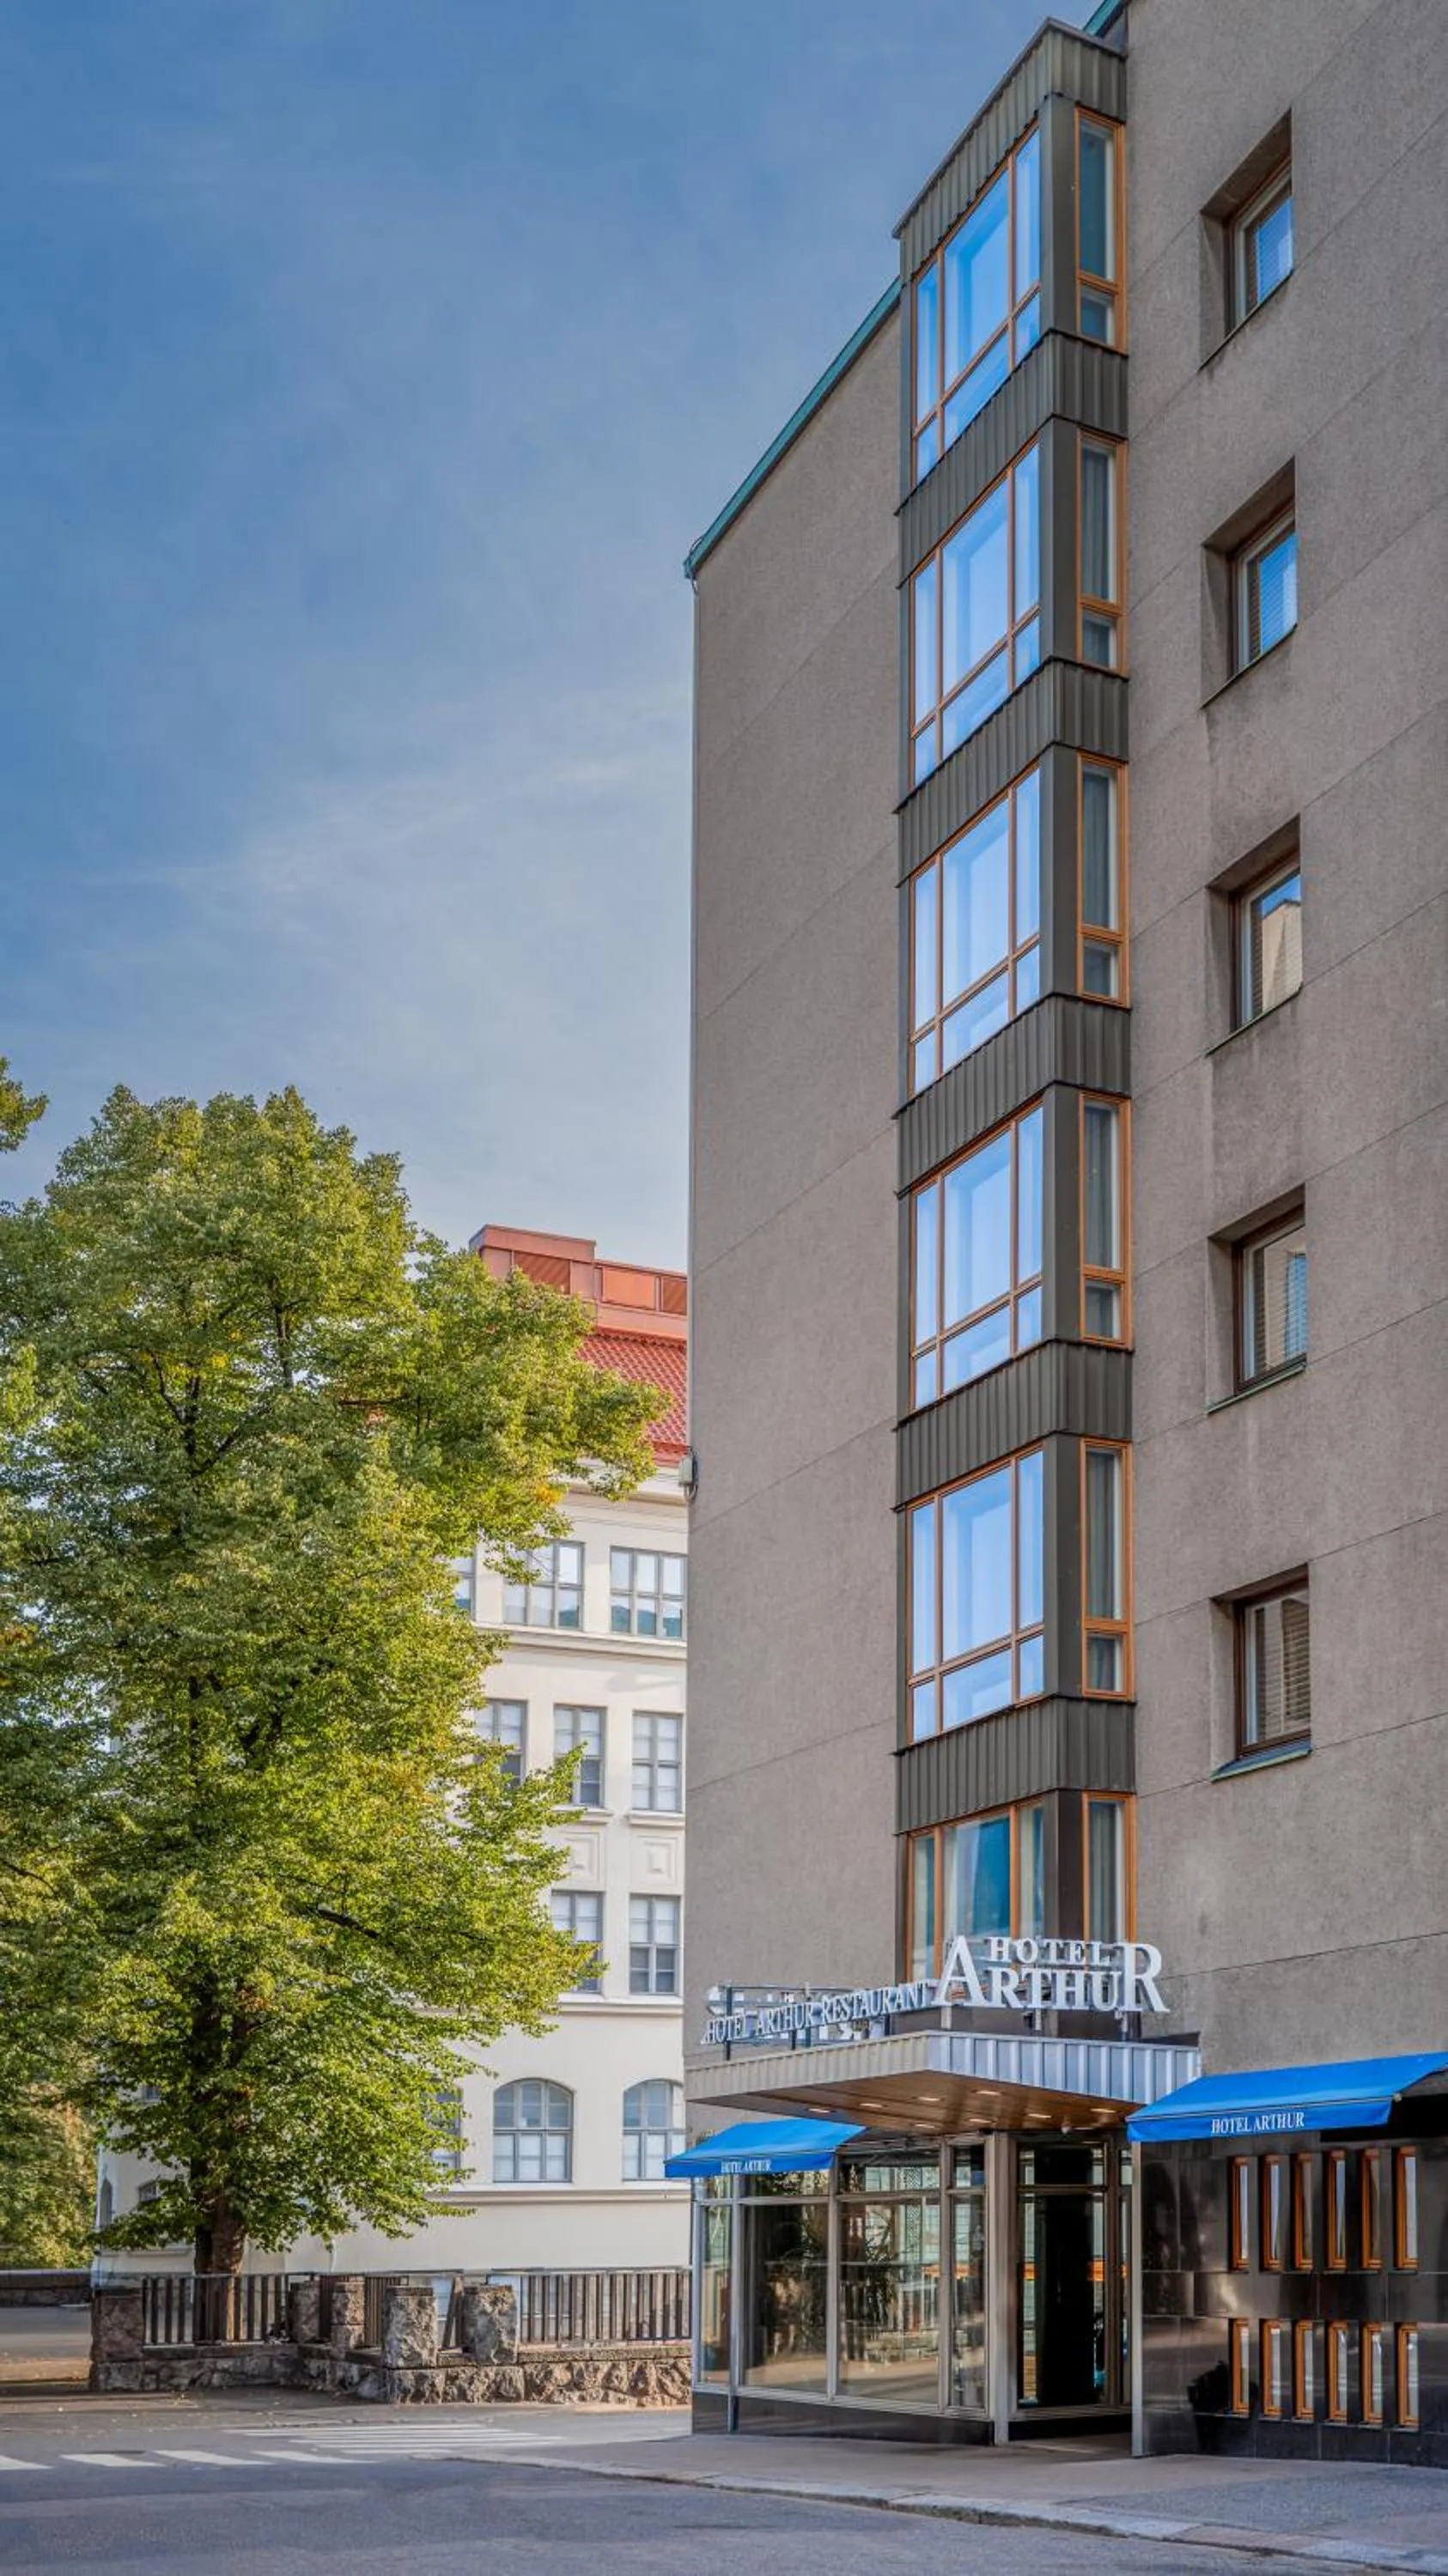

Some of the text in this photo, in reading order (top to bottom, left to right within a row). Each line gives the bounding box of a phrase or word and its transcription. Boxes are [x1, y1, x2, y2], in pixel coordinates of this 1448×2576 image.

[931, 1935, 1171, 2013] ARTHUR
[985, 1936, 1112, 1966] HOTEL
[701, 2014, 749, 2044] HOTEL
[757, 2002, 821, 2034] ARTHUR
[819, 1978, 938, 2025] RESTAURANT
[1211, 2111, 1305, 2135] HOTEL ARTHUR
